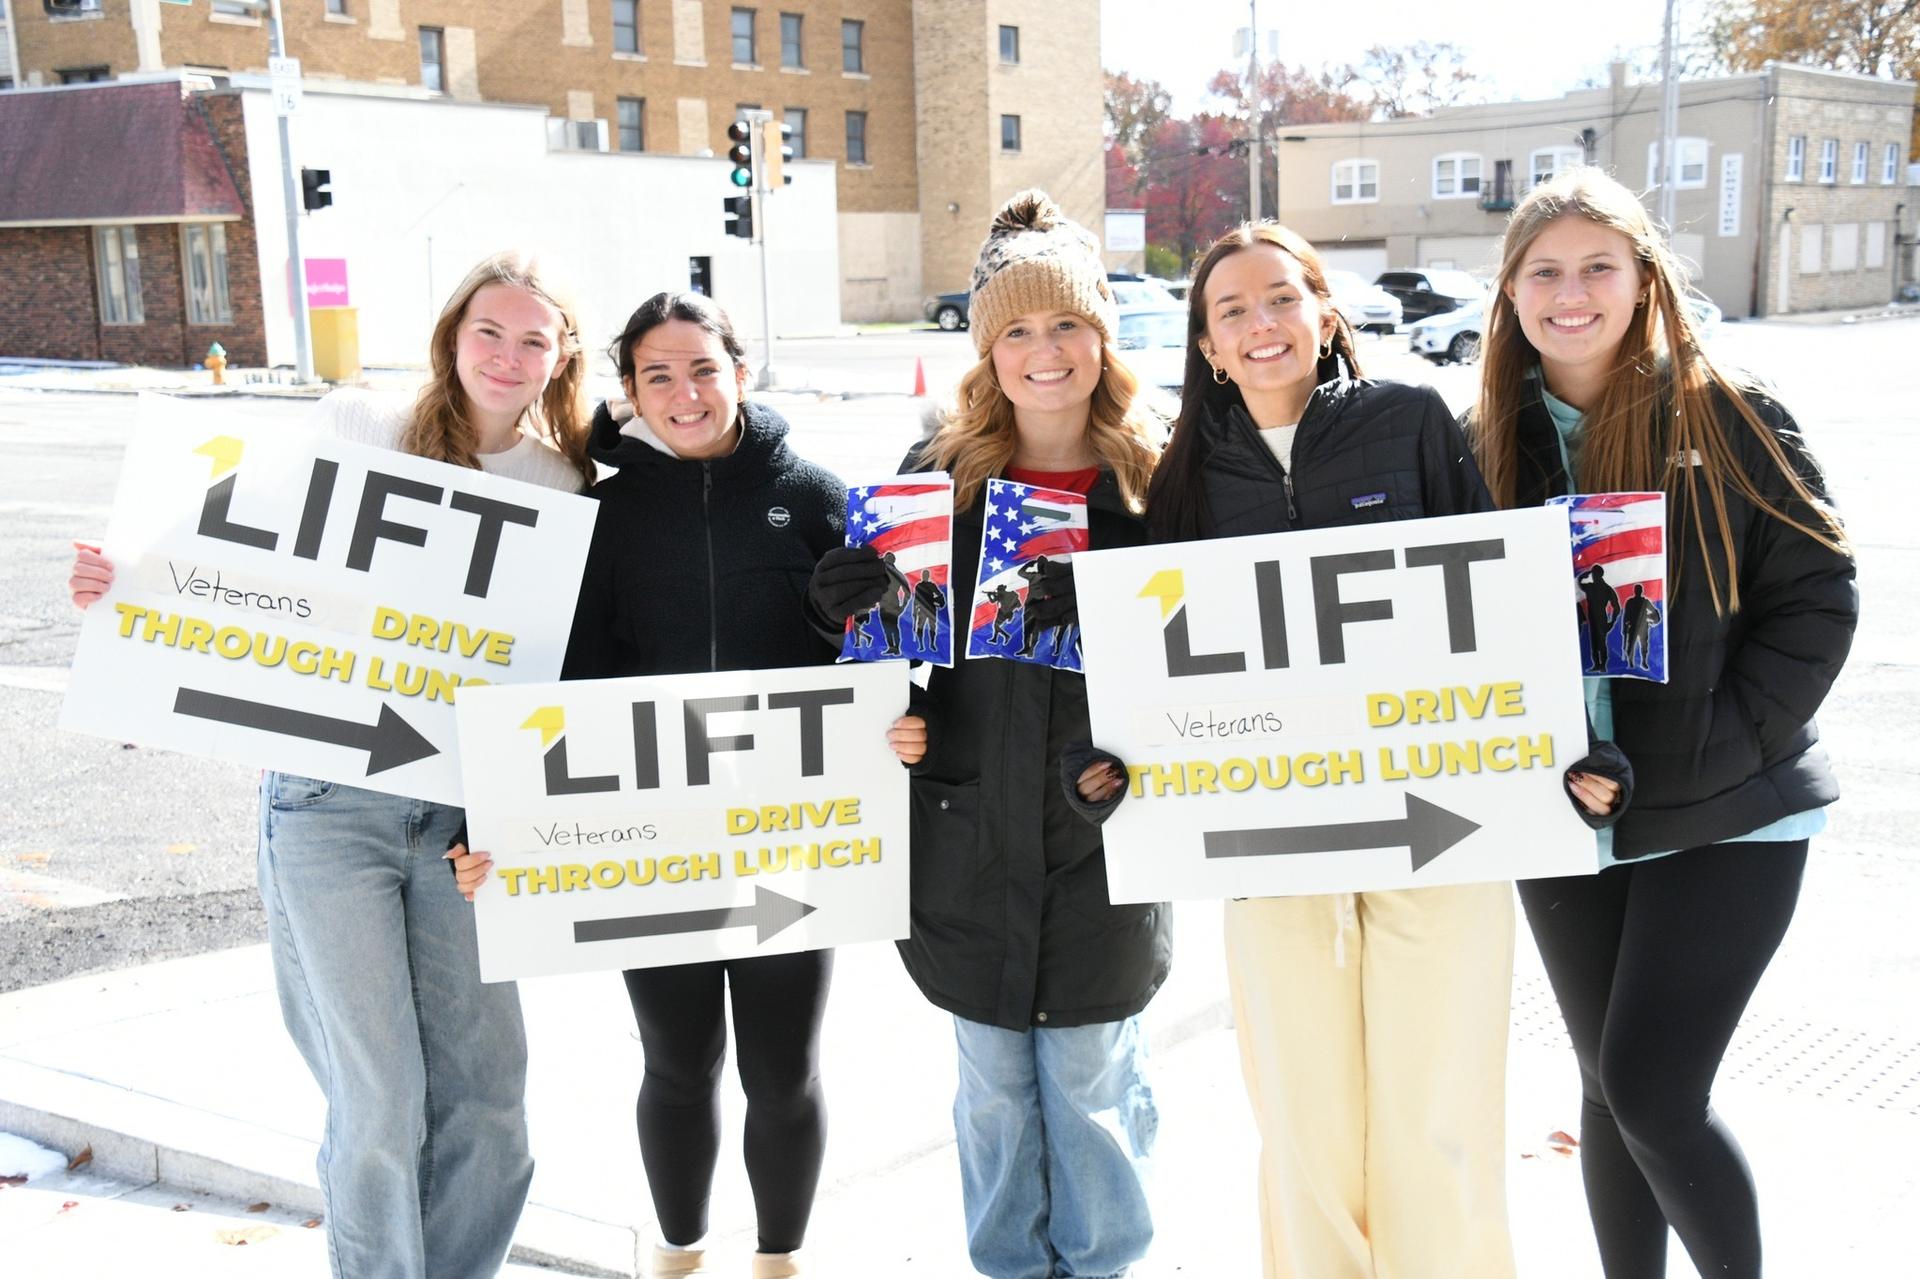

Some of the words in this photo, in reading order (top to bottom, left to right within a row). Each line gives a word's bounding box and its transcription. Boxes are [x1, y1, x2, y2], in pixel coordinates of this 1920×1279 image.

[169, 561, 312, 618] Veterans
[115, 602, 355, 682] THROUGH
[367, 656, 492, 704] LUN
[371, 606, 515, 665] DRIVE
[1166, 709, 1283, 738] Veterans
[1366, 681, 1526, 727] DRIVE
[1127, 750, 1363, 797] THROUGH
[1380, 733, 1554, 781] LUNCH
[533, 822, 657, 846] Veterans
[726, 797, 861, 836] DRIVE
[497, 852, 720, 896] THROUGH
[734, 836, 881, 877] LUNCH
